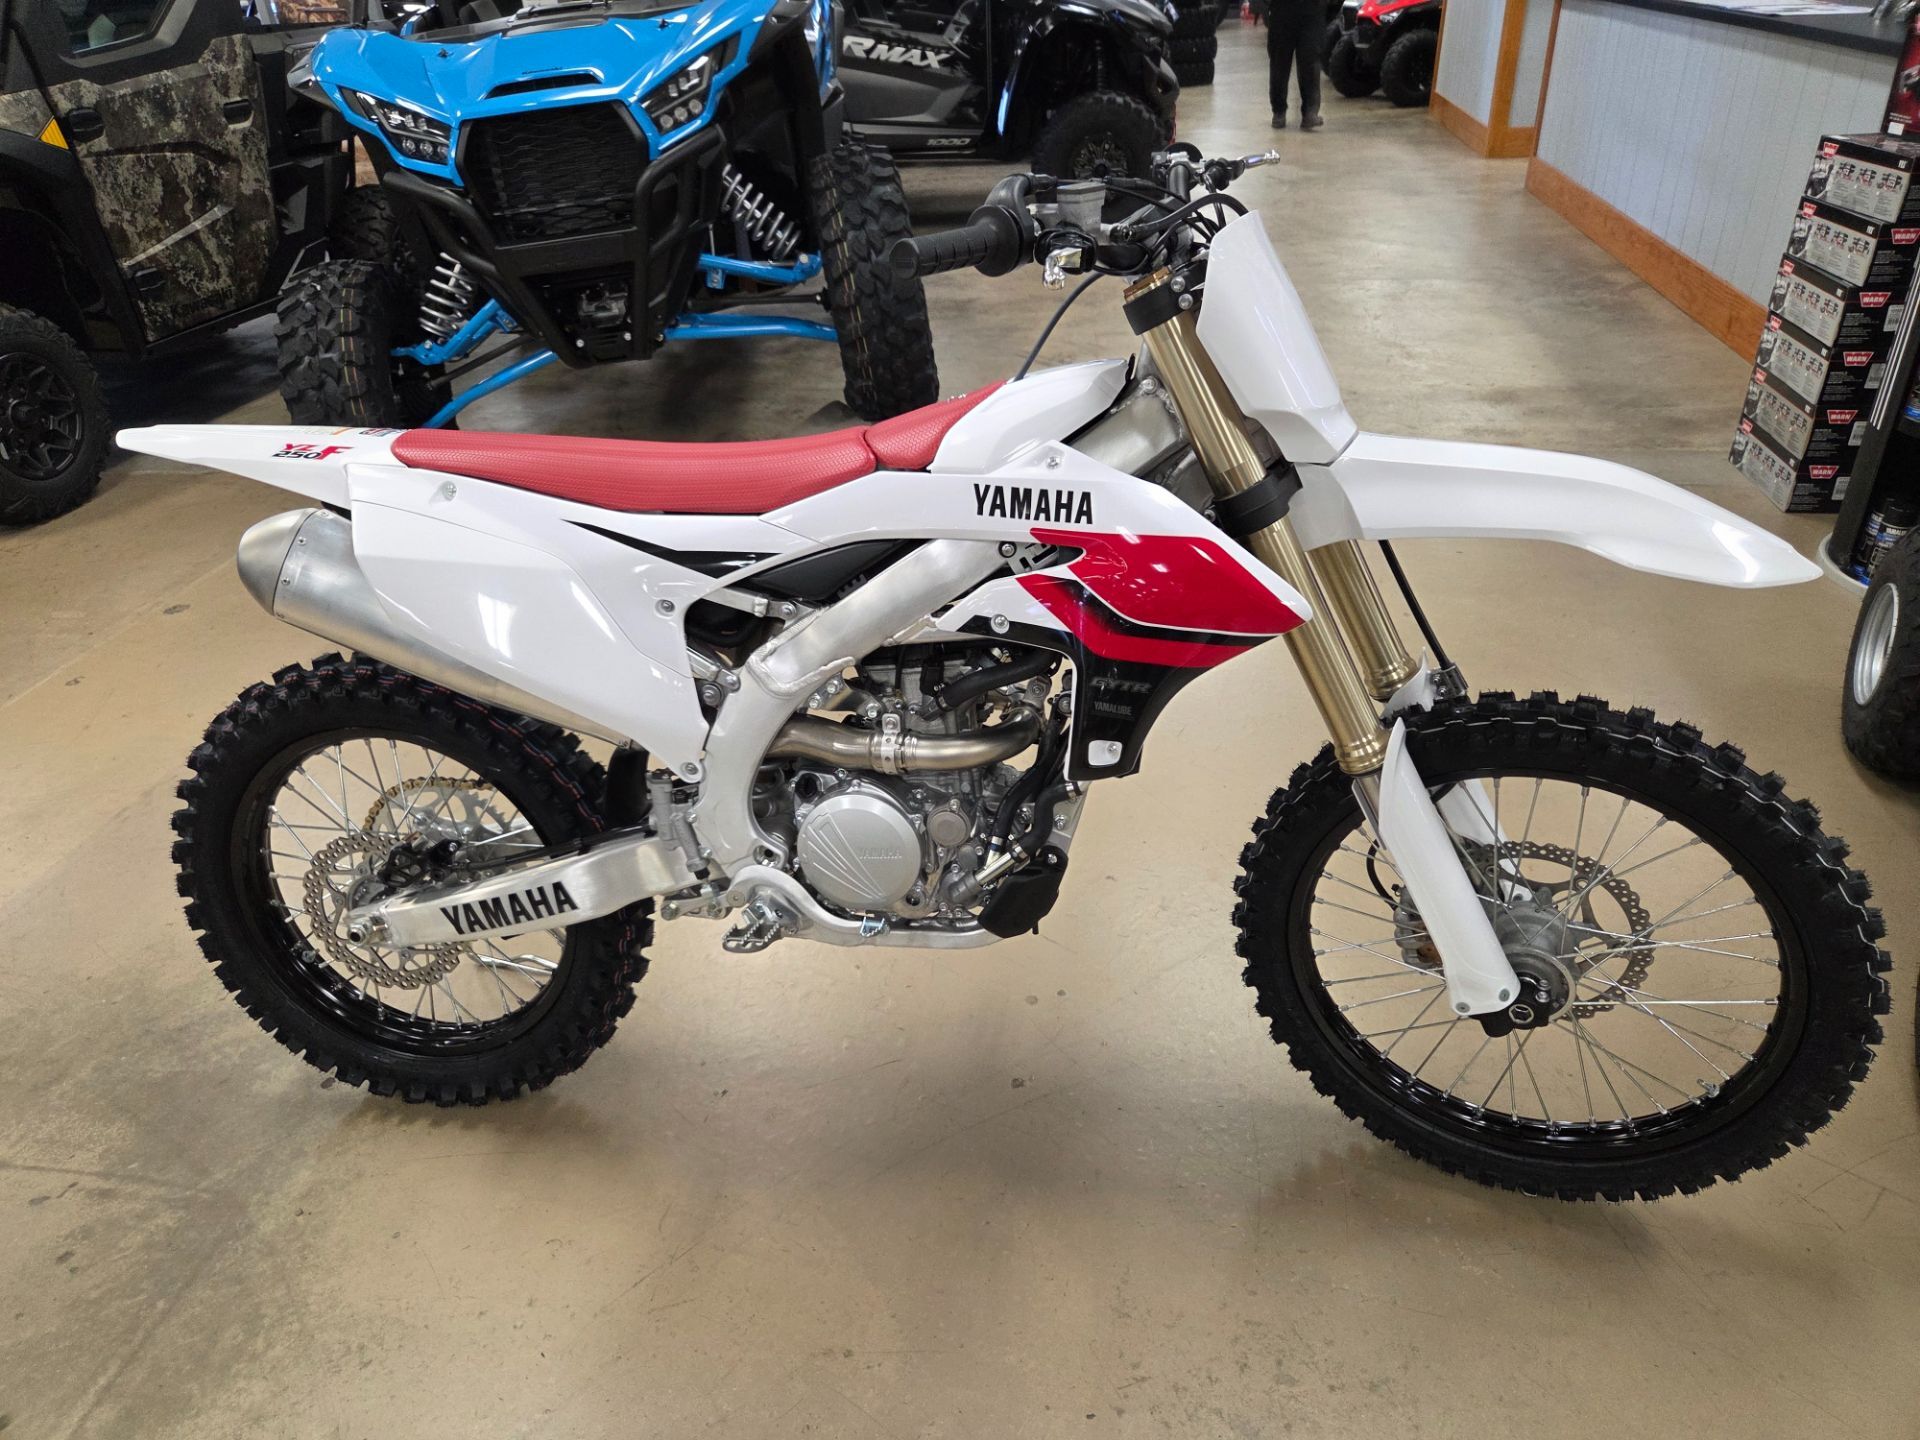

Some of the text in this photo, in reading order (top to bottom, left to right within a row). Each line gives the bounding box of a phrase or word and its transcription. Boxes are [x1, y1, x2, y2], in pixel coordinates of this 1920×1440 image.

[843, 35, 951, 69] RMAX
[927, 138, 971, 146] 1000
[973, 483, 1093, 525] YAMAHA
[1094, 701, 1133, 716] YAMALUBE
[440, 881, 579, 935] YAMAHA
